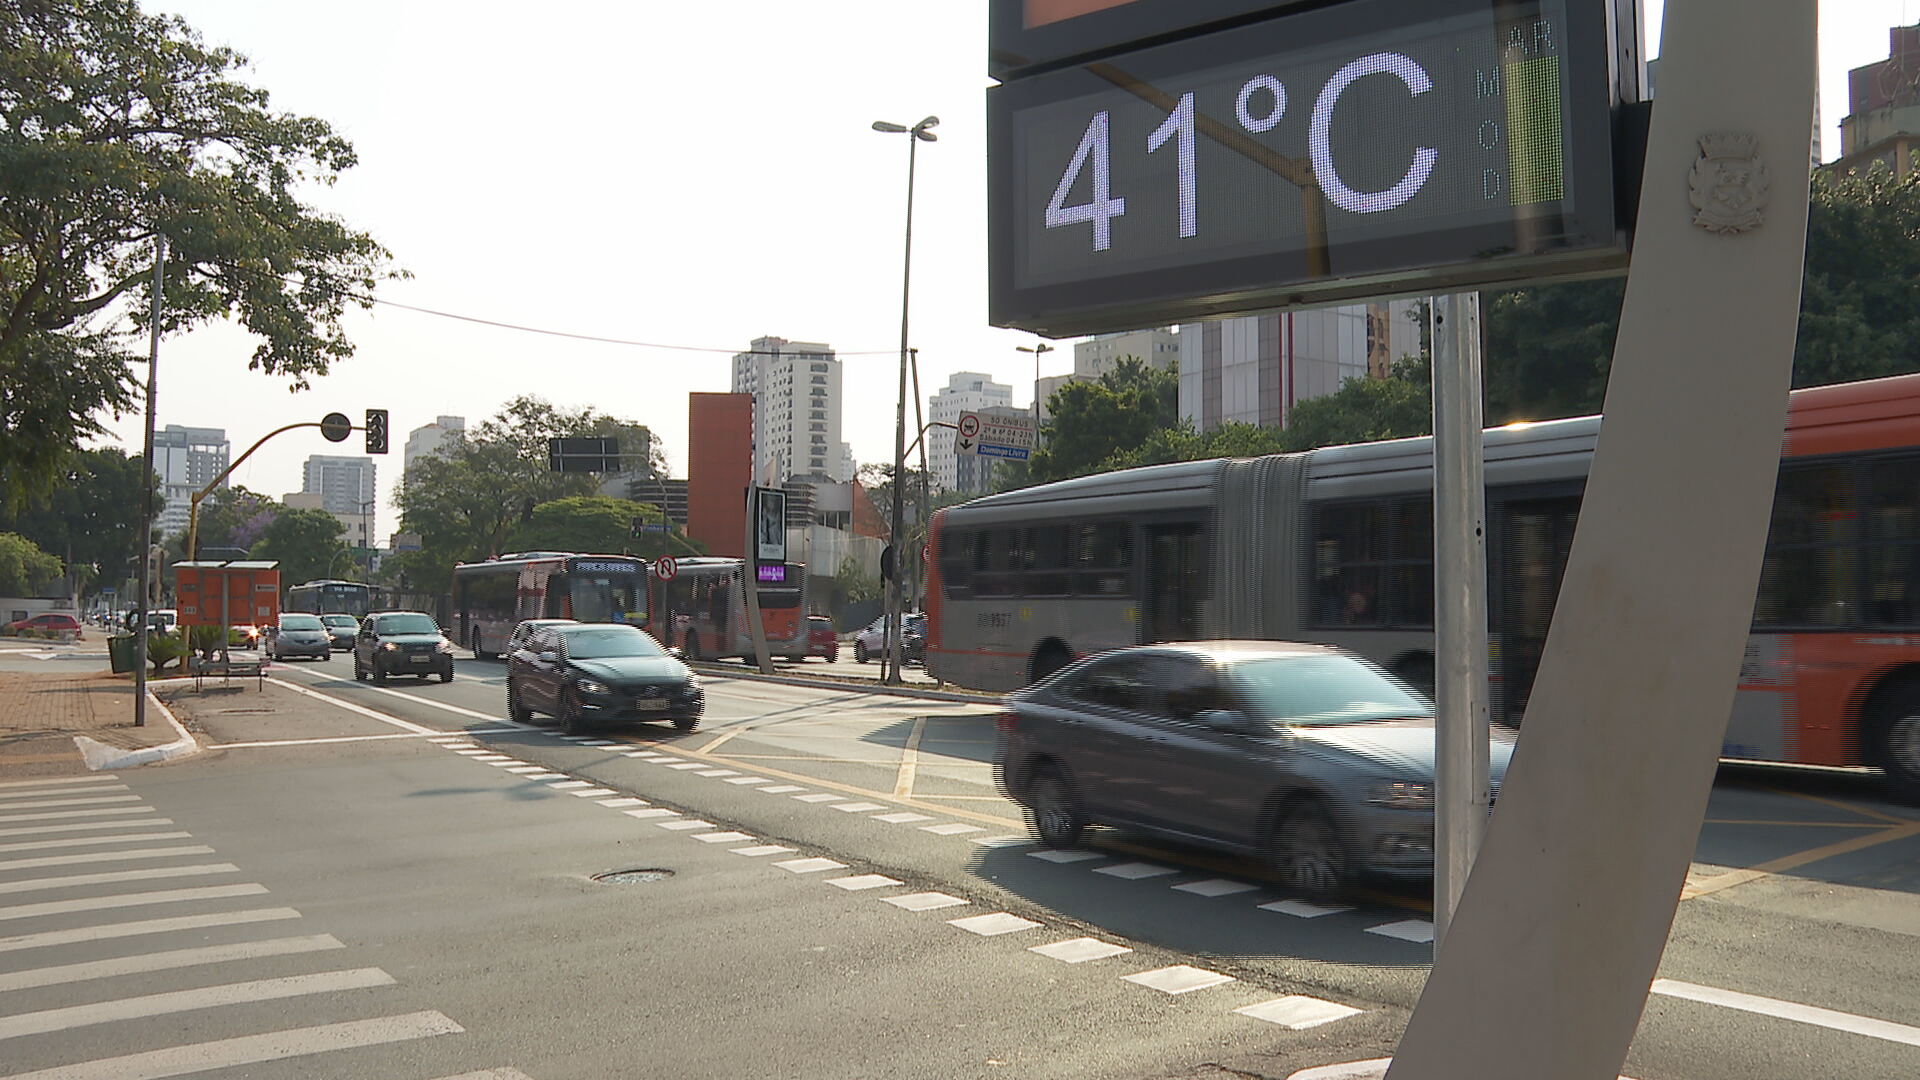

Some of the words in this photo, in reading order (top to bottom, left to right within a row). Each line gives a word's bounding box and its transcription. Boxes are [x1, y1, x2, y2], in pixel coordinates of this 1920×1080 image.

[1505, 20, 1555, 58] AR
[1476, 65, 1501, 200] MOD
[980, 446, 1008, 456] Domingo
[1009, 448, 1026, 457] Livre
